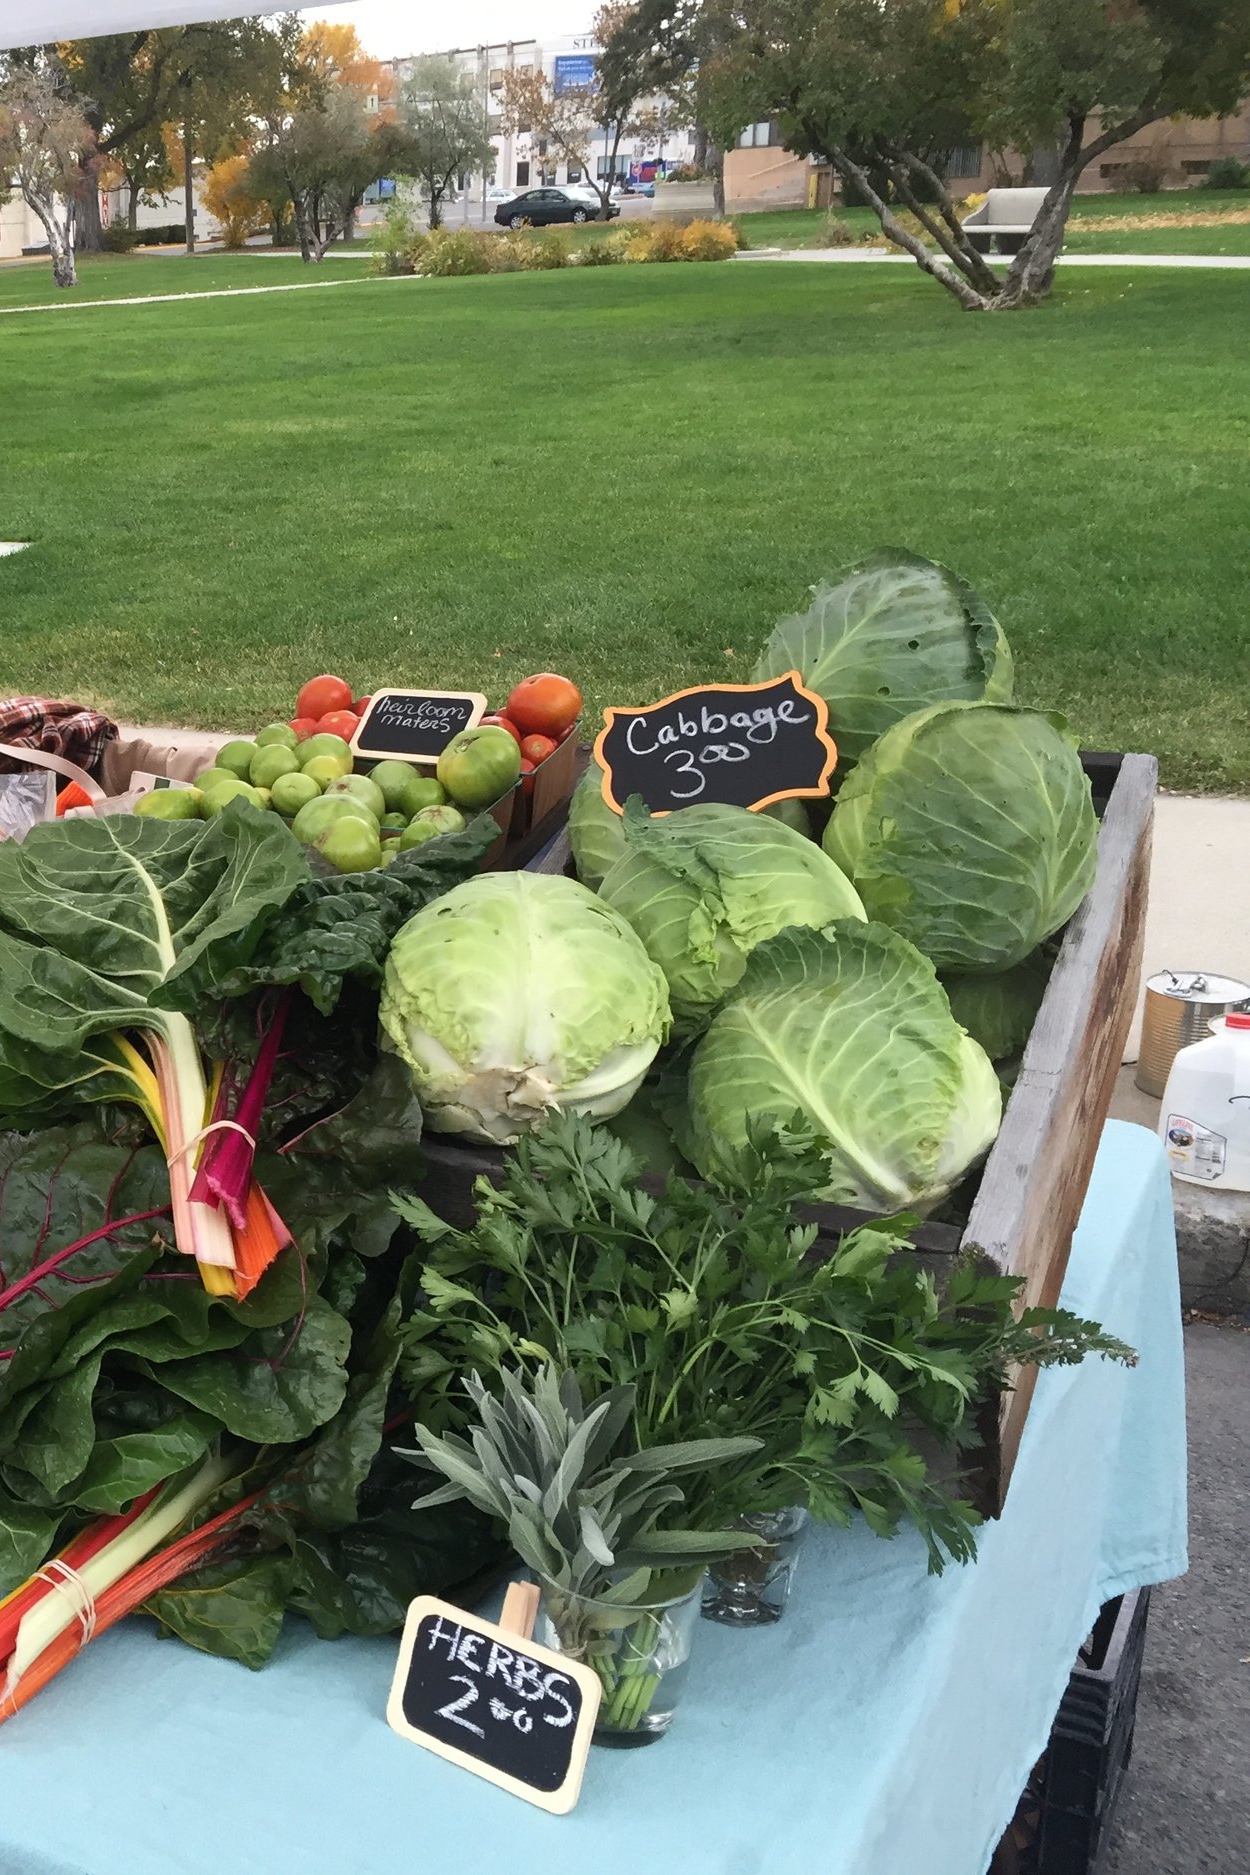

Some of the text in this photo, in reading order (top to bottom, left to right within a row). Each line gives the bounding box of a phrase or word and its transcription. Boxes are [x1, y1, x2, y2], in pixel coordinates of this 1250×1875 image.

[376, 696, 466, 720] heirloom
[626, 700, 811, 756] Cabbage
[428, 1616, 576, 1728] HERBS
